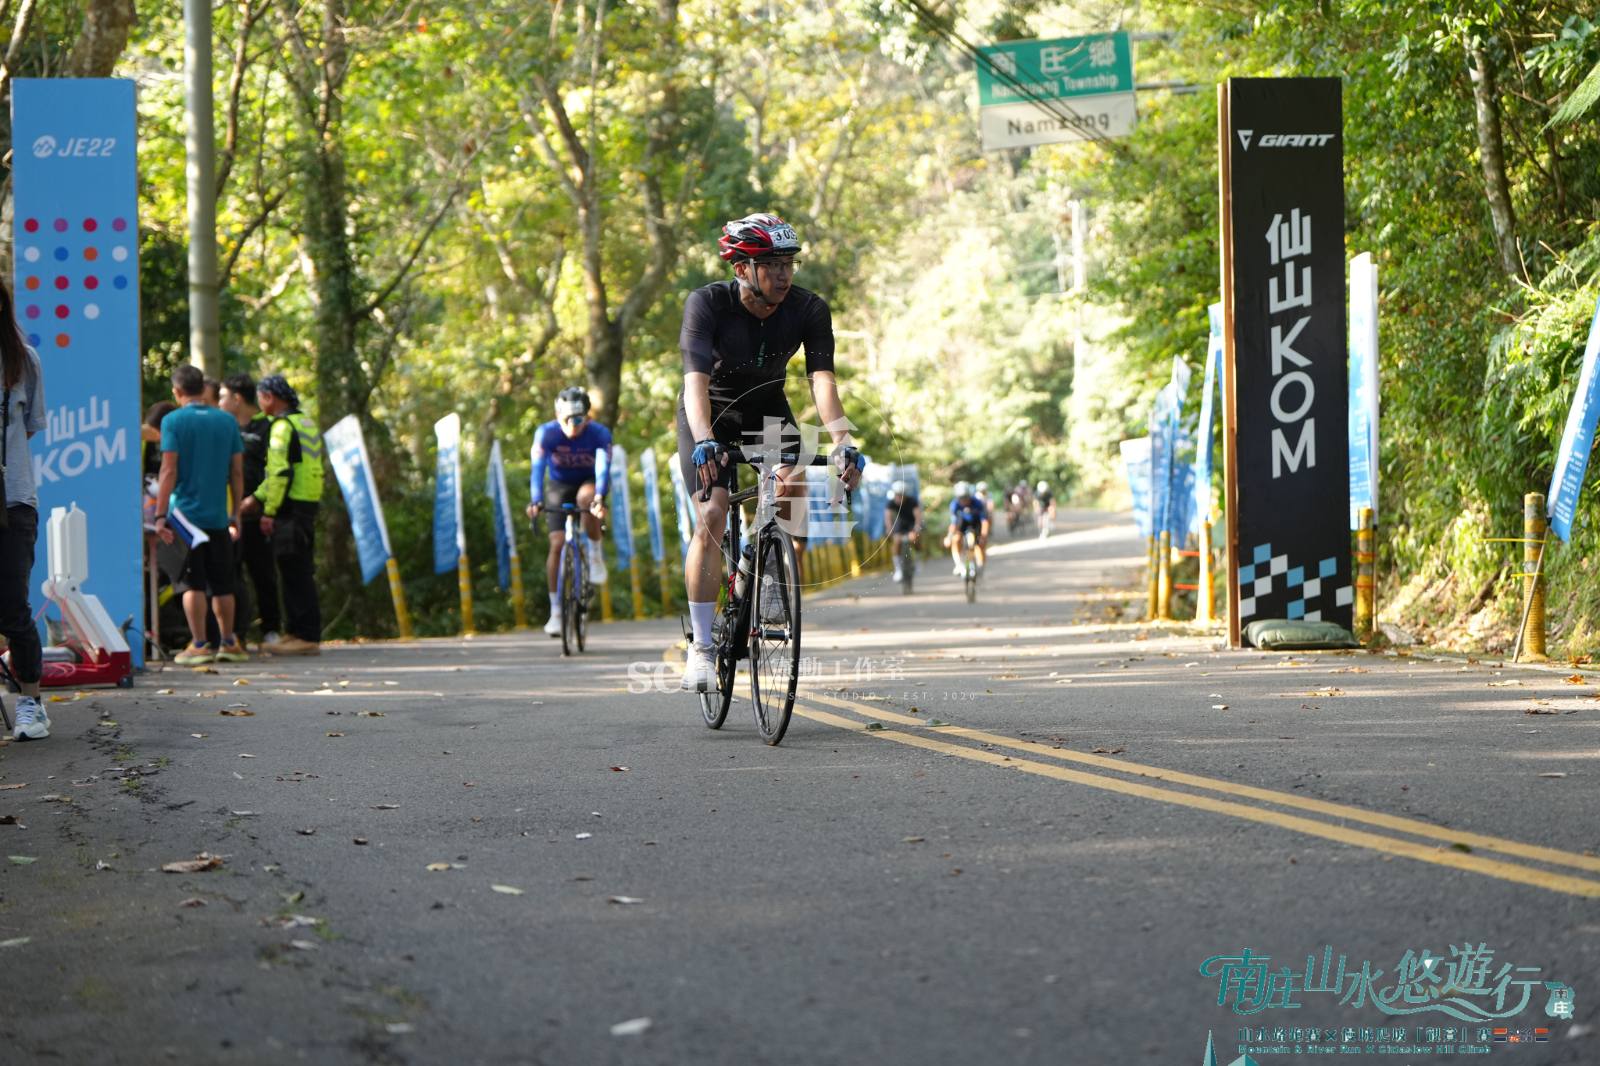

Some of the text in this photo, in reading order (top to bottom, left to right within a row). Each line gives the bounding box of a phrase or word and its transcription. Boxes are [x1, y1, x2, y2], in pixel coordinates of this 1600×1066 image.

[1062, 73, 1119, 91] Township
[58, 137, 116, 157] JE22
[1258, 132, 1336, 148] GIANT
[34, 428, 127, 487] KOM
